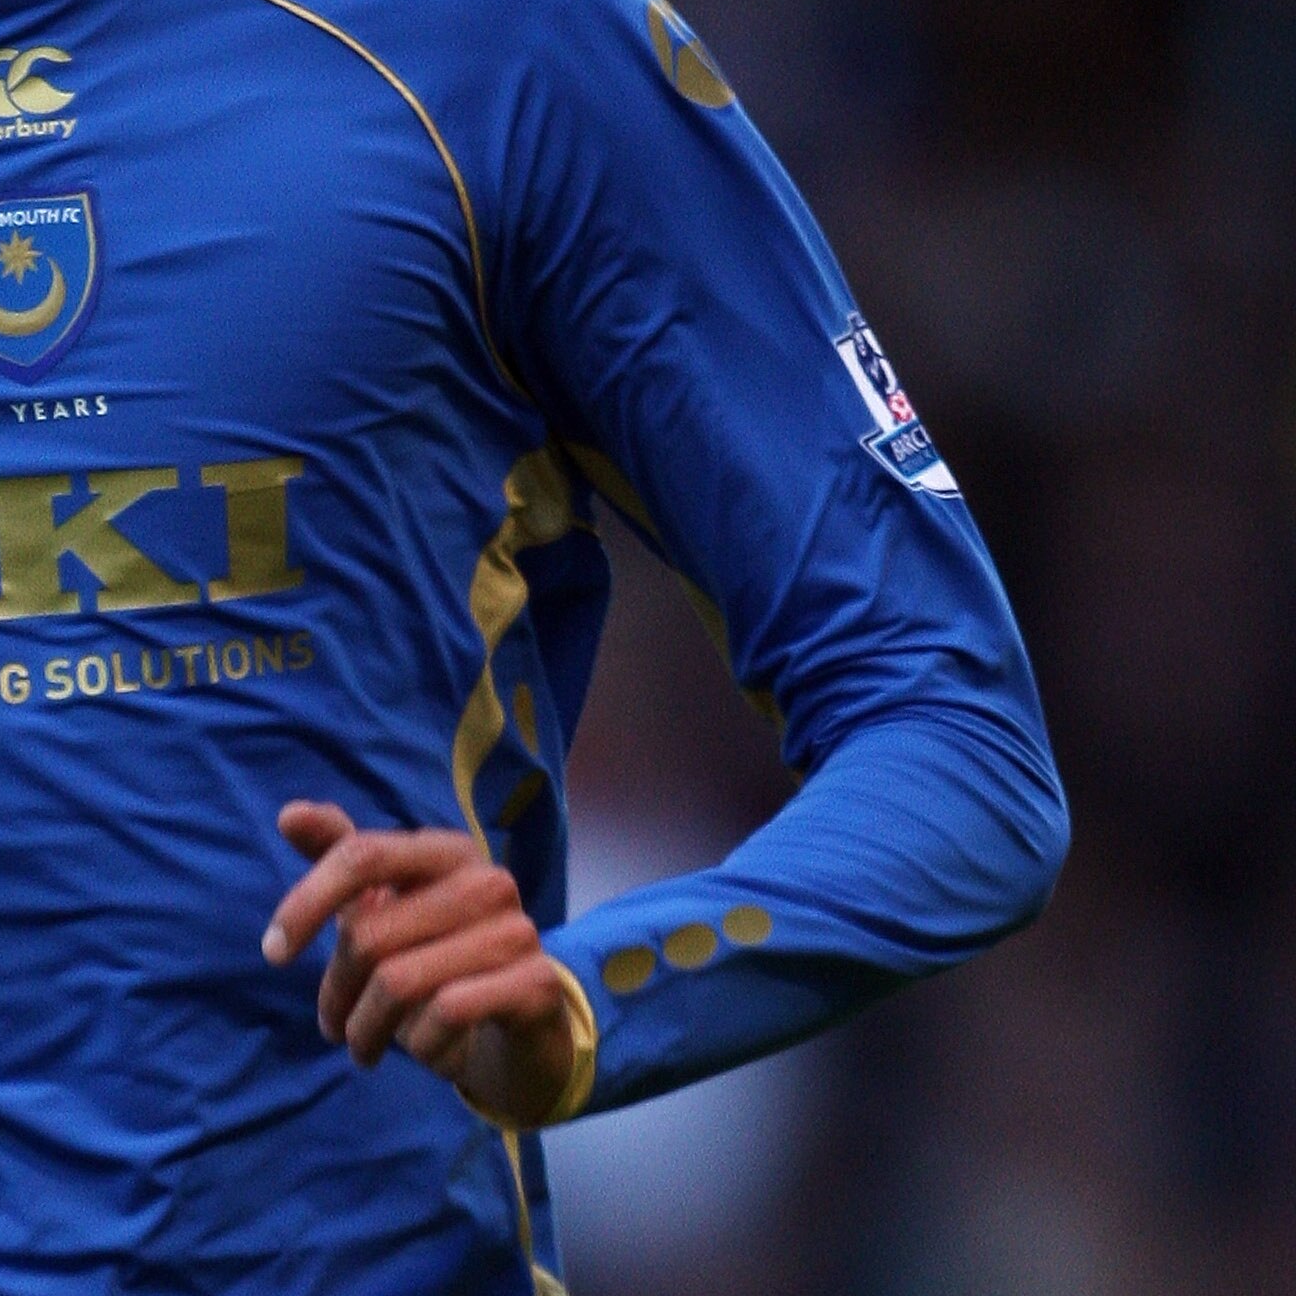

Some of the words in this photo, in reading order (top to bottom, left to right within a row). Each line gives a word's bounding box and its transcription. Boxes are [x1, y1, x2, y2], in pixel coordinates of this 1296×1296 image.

[62, 207, 82, 225] FC
[12, 395, 109, 424] YEARS
[44, 632, 316, 700] SOLUTIONS
